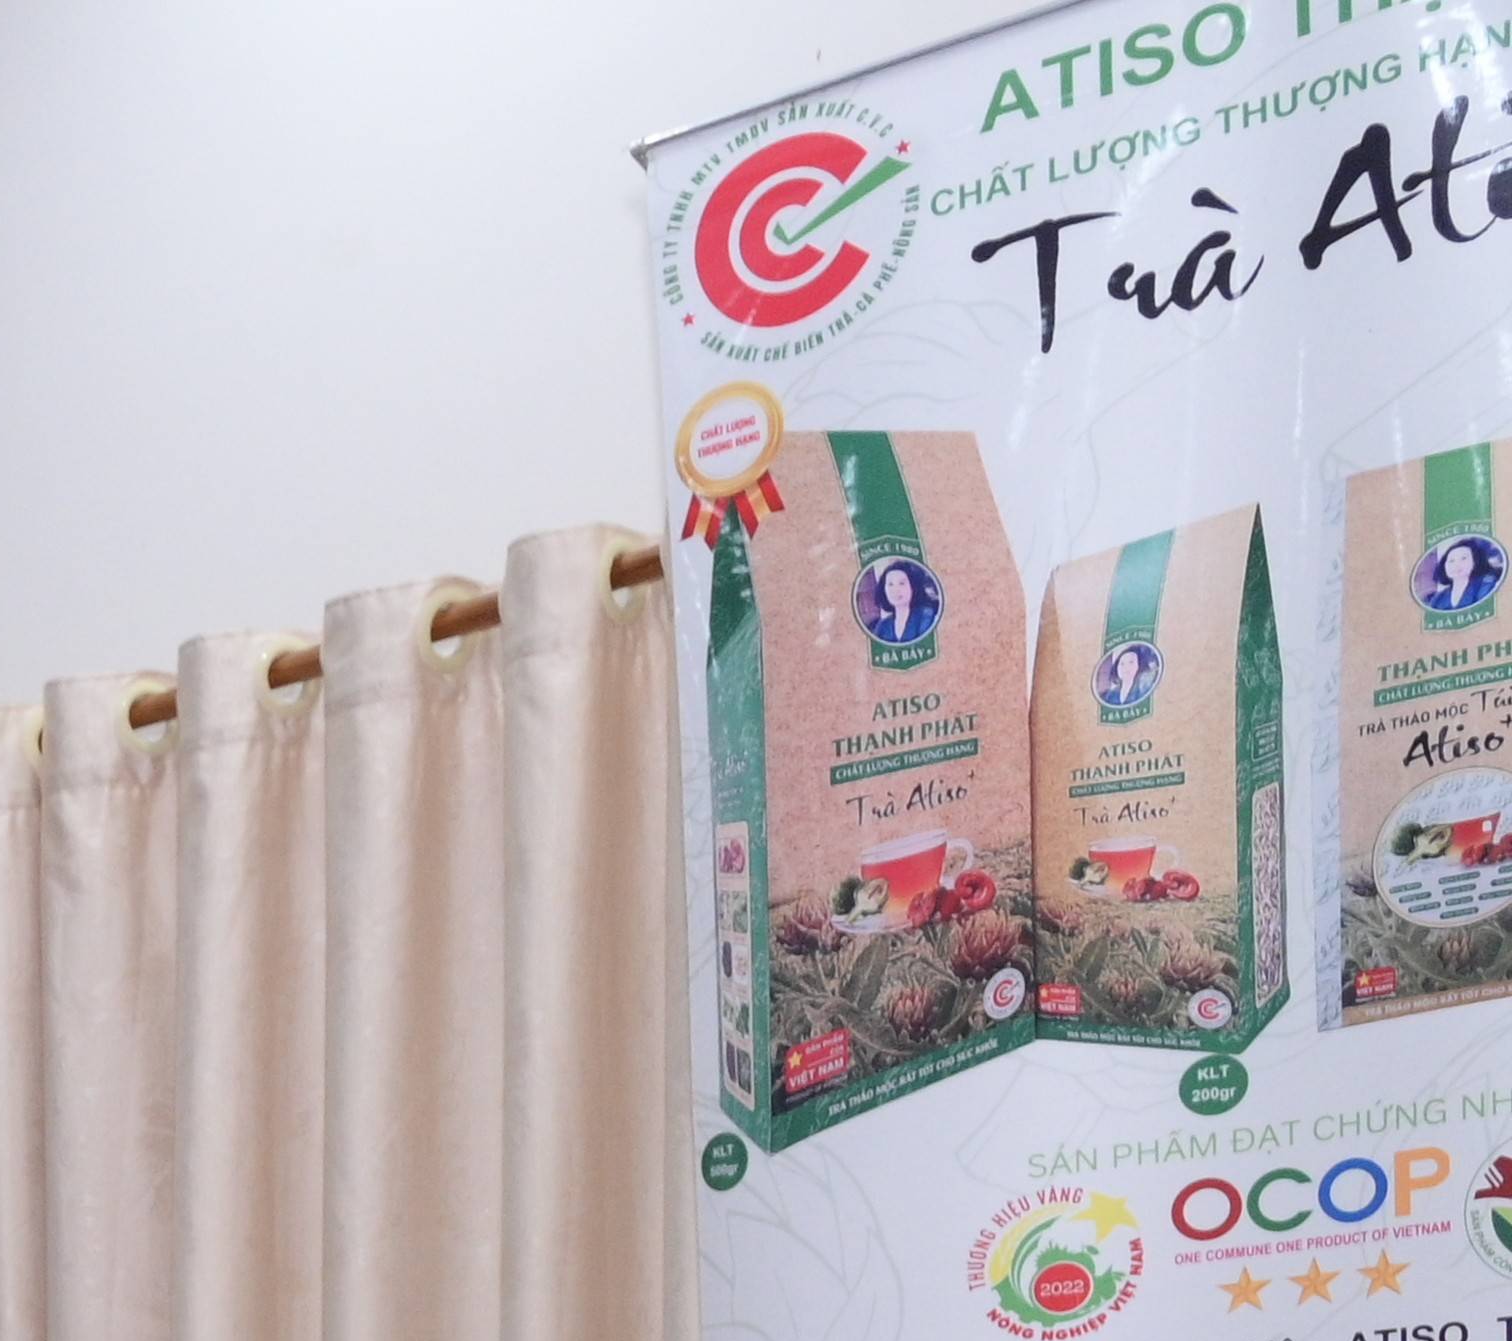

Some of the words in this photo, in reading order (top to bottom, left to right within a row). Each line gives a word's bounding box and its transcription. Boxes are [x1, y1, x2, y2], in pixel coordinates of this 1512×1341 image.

[980, 3, 1246, 134] ATISO
[930, 162, 1034, 216] CHẤT
[1050, 117, 1200, 182] LƯỢNG
[1215, 54, 1402, 134] THƯỢNG
[971, 187, 1264, 353] Trà
[872, 692, 941, 722] ATISO
[921, 714, 978, 740] PHÁT
[1098, 739, 1153, 760] ATISO
[846, 794, 897, 826] Trà
[1197, 1064, 1230, 1081] KLT
[1191, 1086, 1237, 1104] 200gr
[1171, 1146, 1450, 1241] OCOP
[1174, 1253, 1201, 1265] ONE
[1205, 1243, 1271, 1262] COMMUNE
[1276, 1239, 1303, 1254] ONE
[1307, 1231, 1367, 1250] PRODUCT
[1372, 1228, 1389, 1241] OF
[1393, 1221, 1452, 1239] VIETNAM
[1040, 1279, 1085, 1297] 2022
